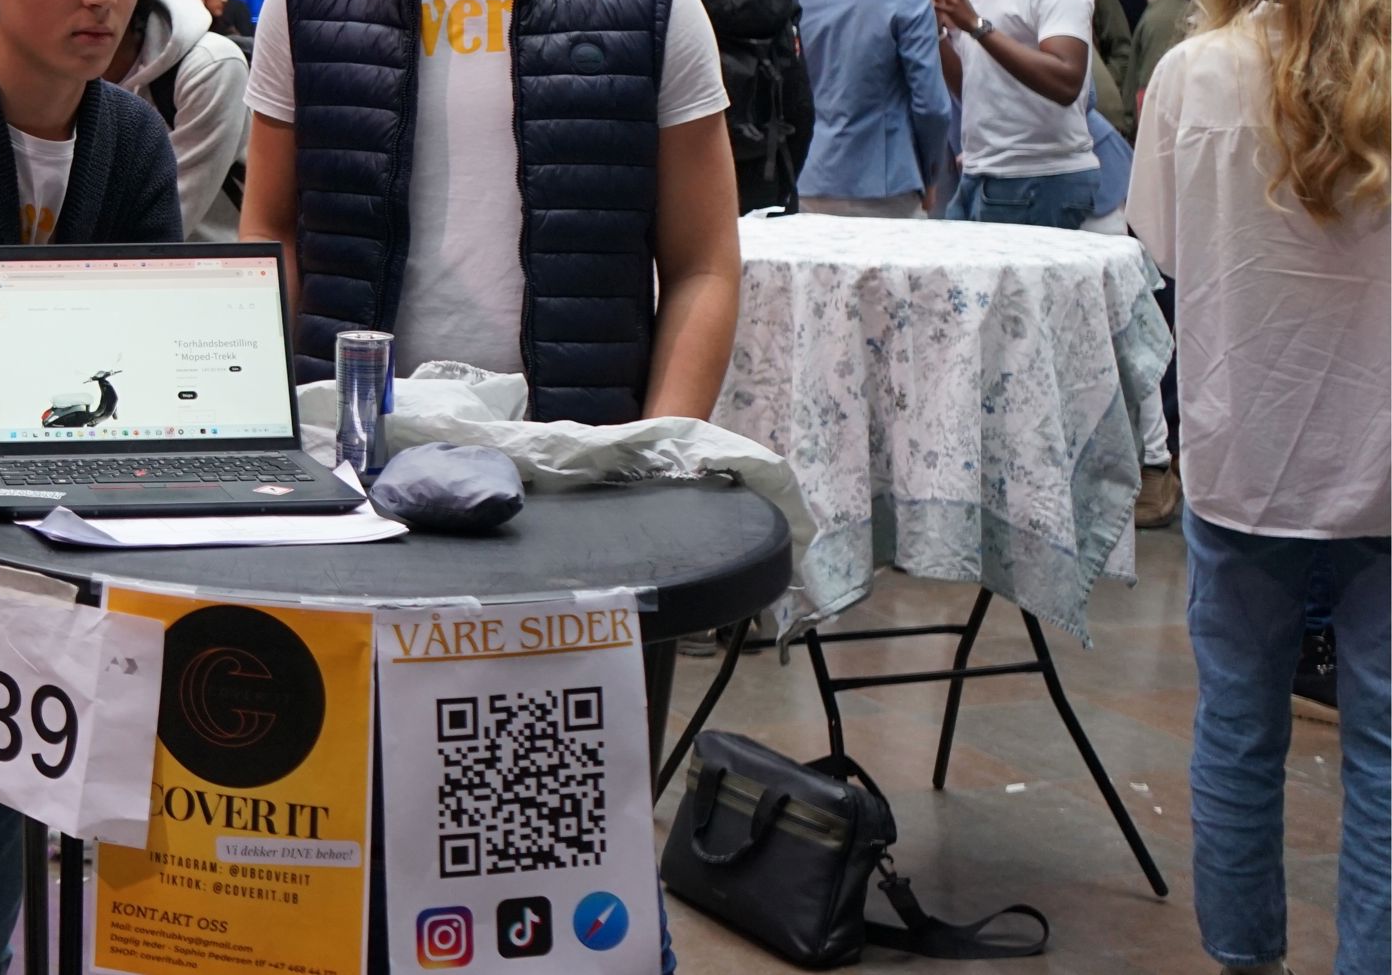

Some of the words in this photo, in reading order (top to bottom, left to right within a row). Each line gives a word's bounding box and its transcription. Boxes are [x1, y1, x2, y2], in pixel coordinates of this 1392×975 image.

[393, 613, 505, 656] VÅRE
[520, 608, 634, 649] SIDER
[286, 802, 330, 840] IT
[149, 851, 224, 874] INSTAGRAM:
[229, 864, 311, 886] @UBCOVERIT
[225, 844, 239, 856] Vi
[241, 845, 279, 859] dekker
[281, 847, 314, 860] DINE
[316, 848, 355, 861] behov!
[159, 872, 208, 892] TIKTOK:
[213, 881, 300, 905] @COVERIT.UB
[110, 921, 133, 931] Mail:
[111, 901, 193, 927] KONTAKT
[196, 917, 229, 934] OSS
